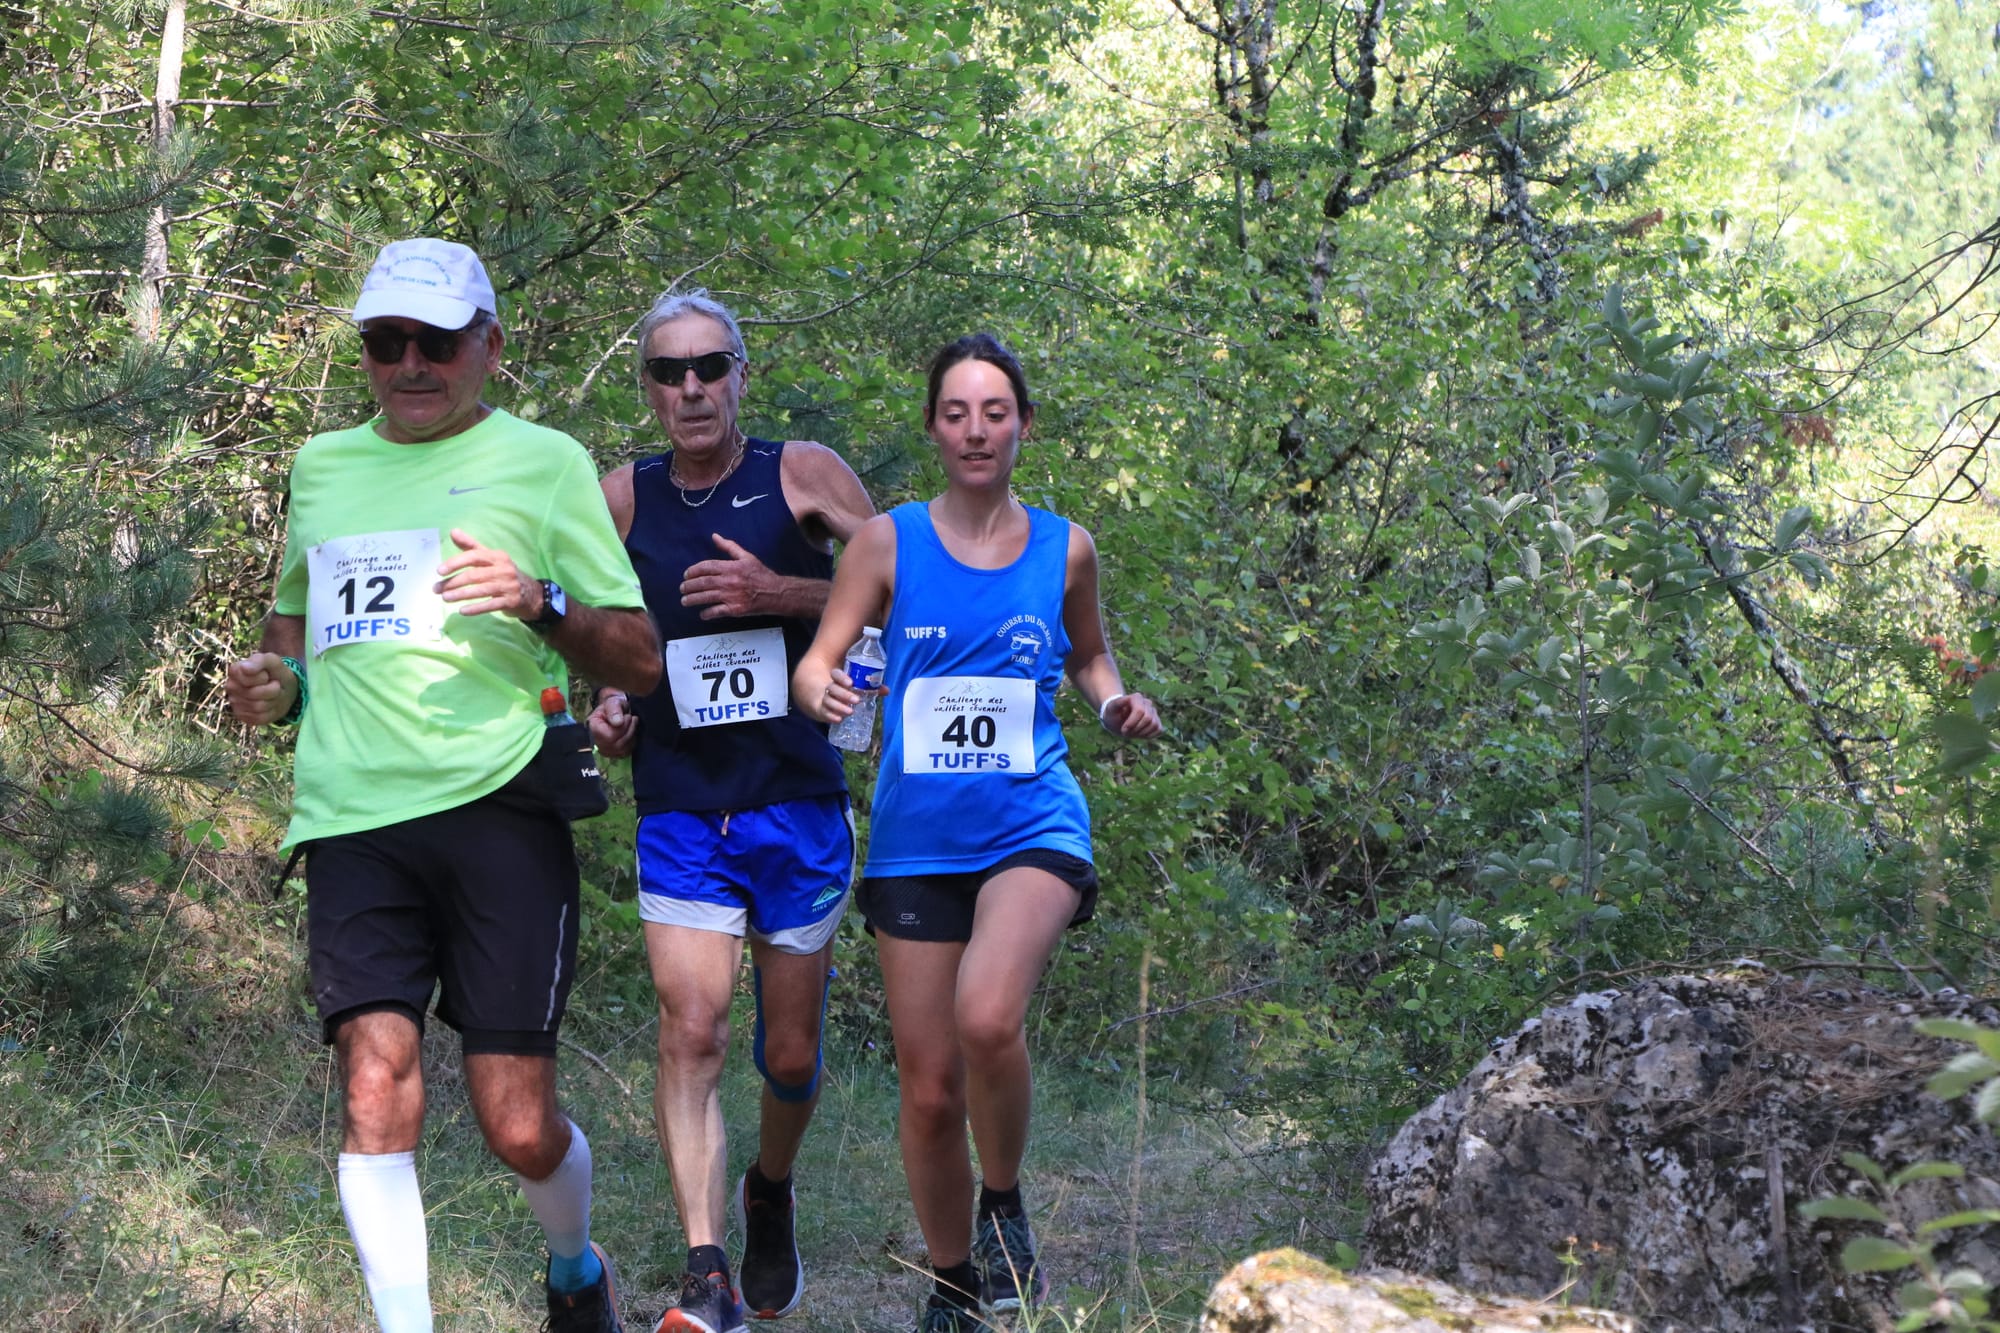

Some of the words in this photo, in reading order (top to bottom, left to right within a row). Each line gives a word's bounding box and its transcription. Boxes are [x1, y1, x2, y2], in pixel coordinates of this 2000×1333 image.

[336, 555, 379, 570] Challenge
[385, 553, 402, 562] des
[338, 575, 395, 615] 12
[325, 617, 411, 643] TUFF'S
[904, 626, 947, 639] TUFF'S
[996, 614, 1024, 638] COURSE
[1024, 614, 1036, 624] DU
[695, 651, 737, 663] Challenge
[741, 649, 756, 657] des
[692, 660, 720, 671] vallées
[701, 667, 755, 702] 70
[934, 703, 964, 713] vallées
[939, 696, 983, 705] Challenge
[988, 696, 1003, 704] des
[695, 700, 770, 723] TUFF'S
[942, 715, 996, 748] 40
[929, 752, 1011, 769] TUFF'S
